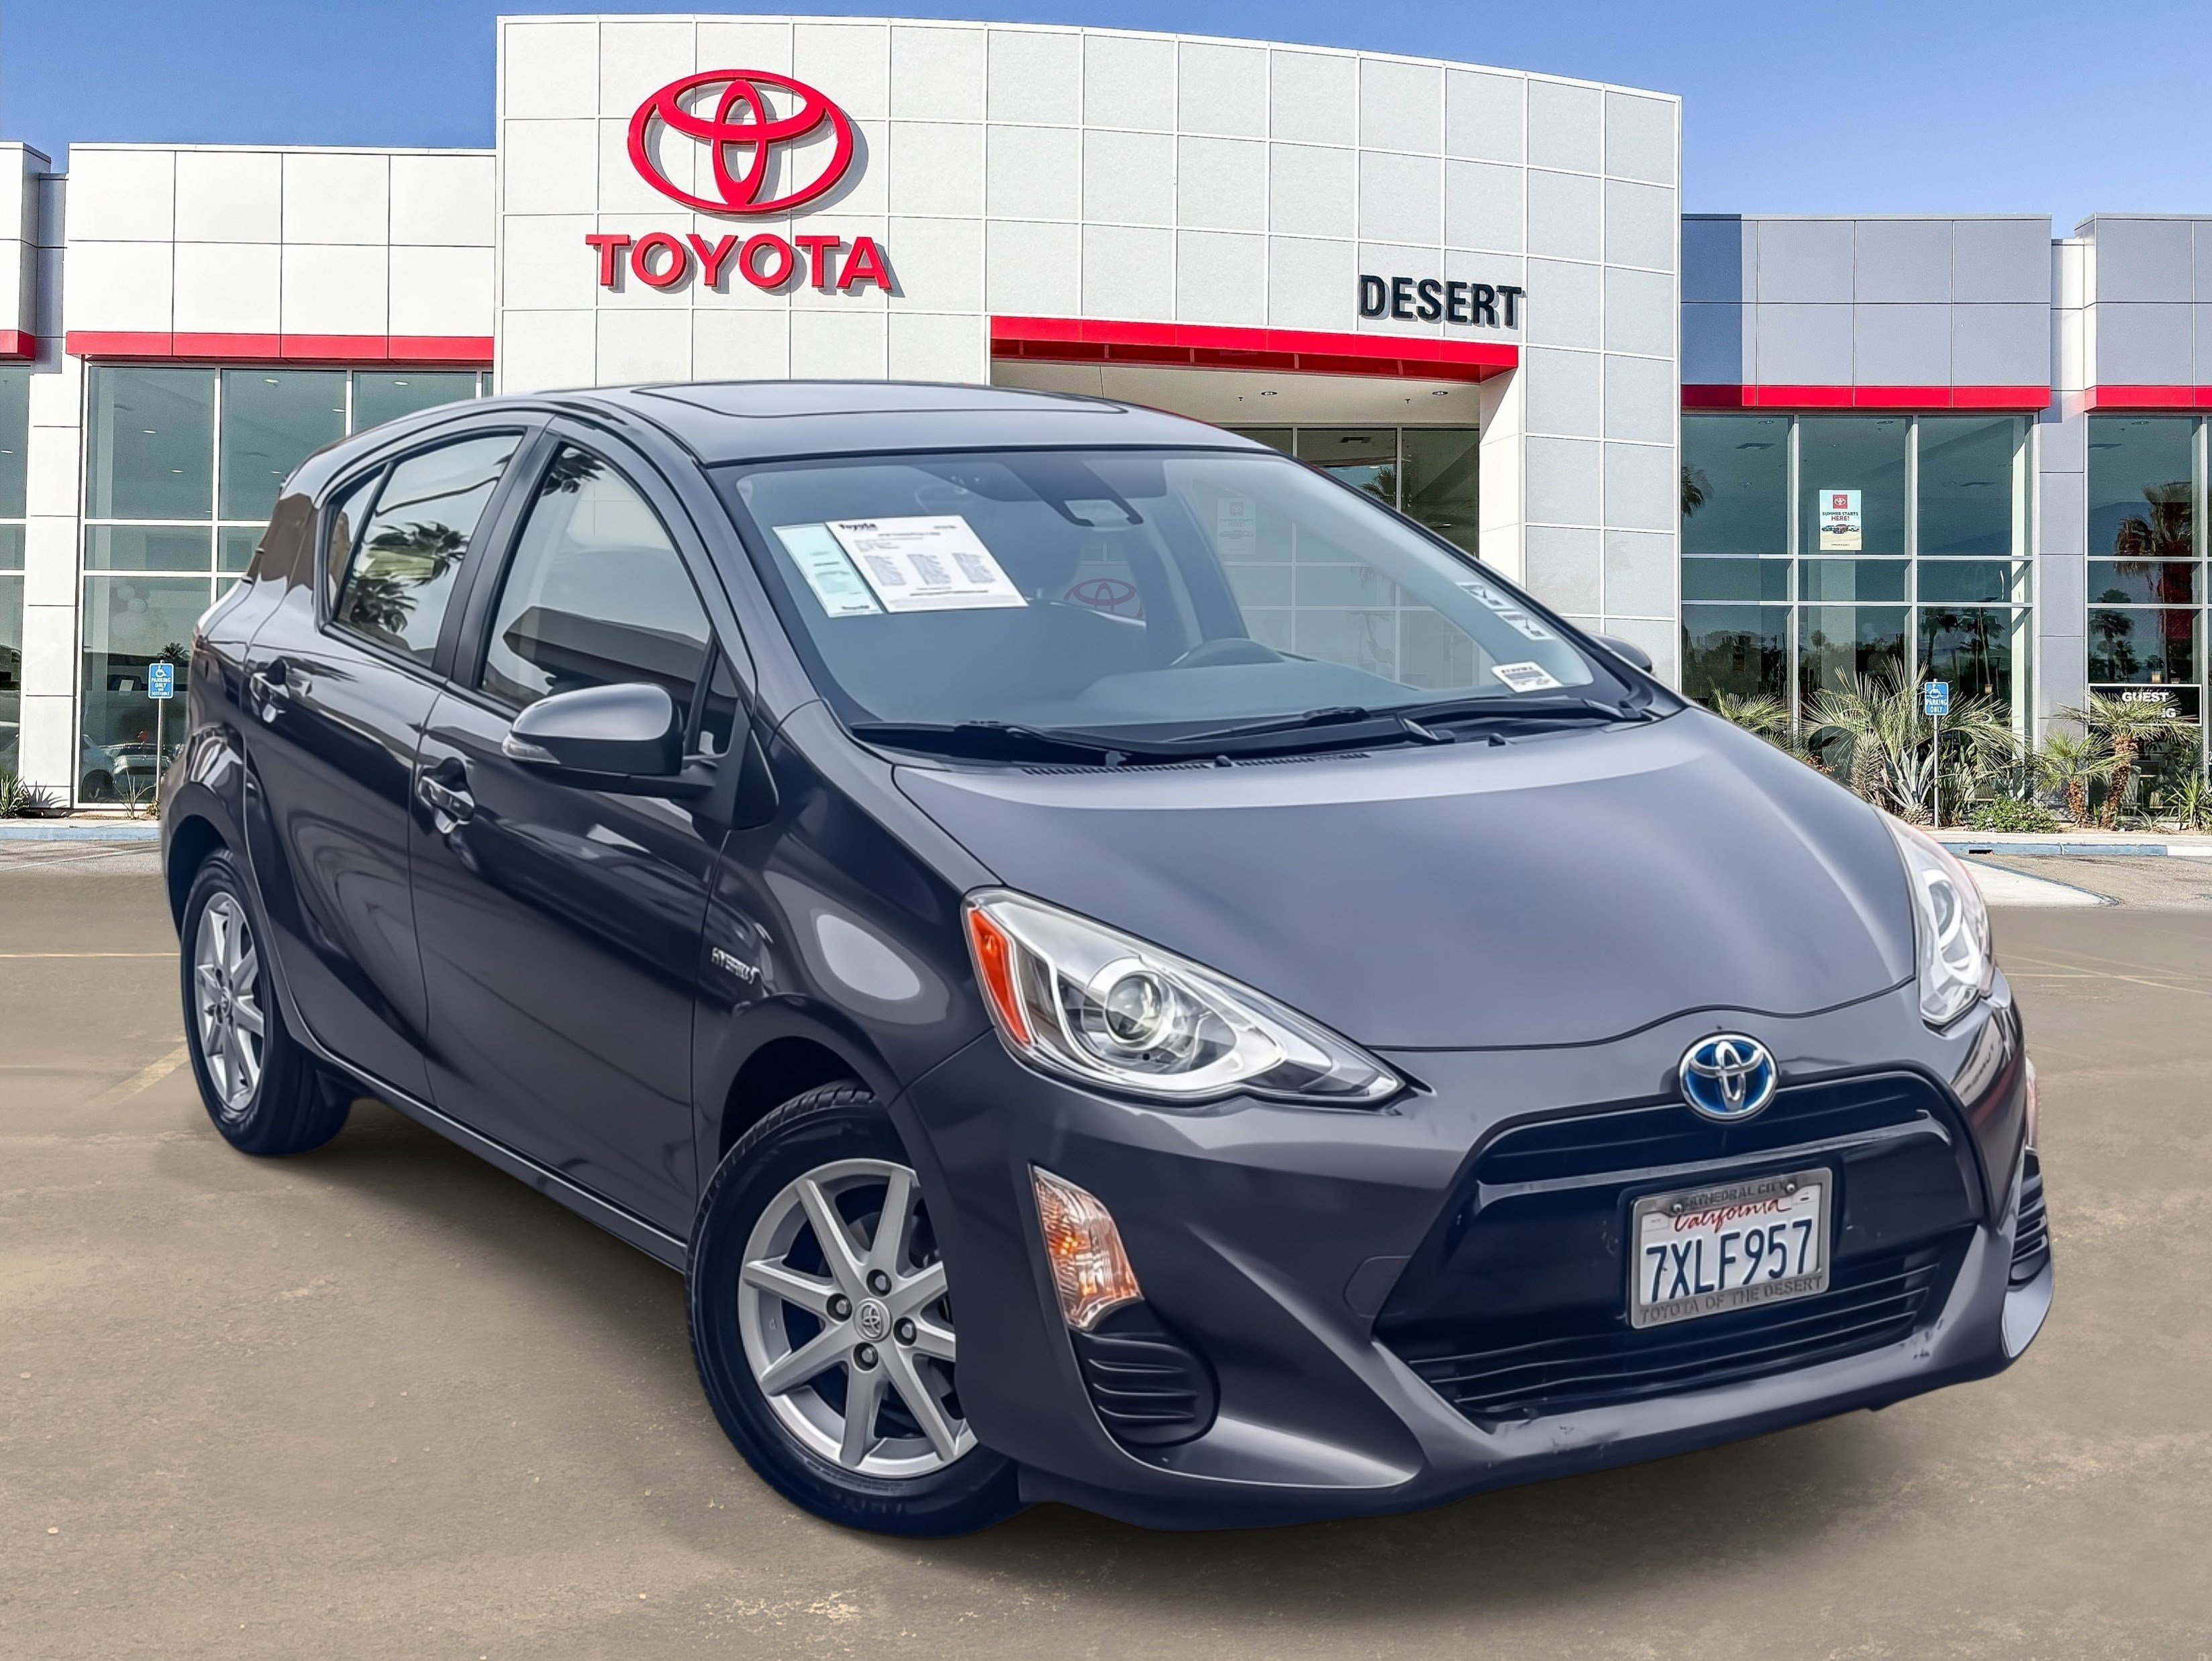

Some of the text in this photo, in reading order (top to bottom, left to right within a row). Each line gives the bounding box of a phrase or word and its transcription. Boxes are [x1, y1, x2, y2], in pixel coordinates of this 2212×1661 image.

[585, 232, 893, 290] TOYOTA
[1359, 274, 1522, 327] DESERT
[2121, 692, 2169, 702] GUEST
[1674, 1199, 1792, 1234] California
[1646, 1218, 1812, 1303] 7XLF957
[1640, 1276, 1823, 1323] TOYOTA OF THE DESERT
